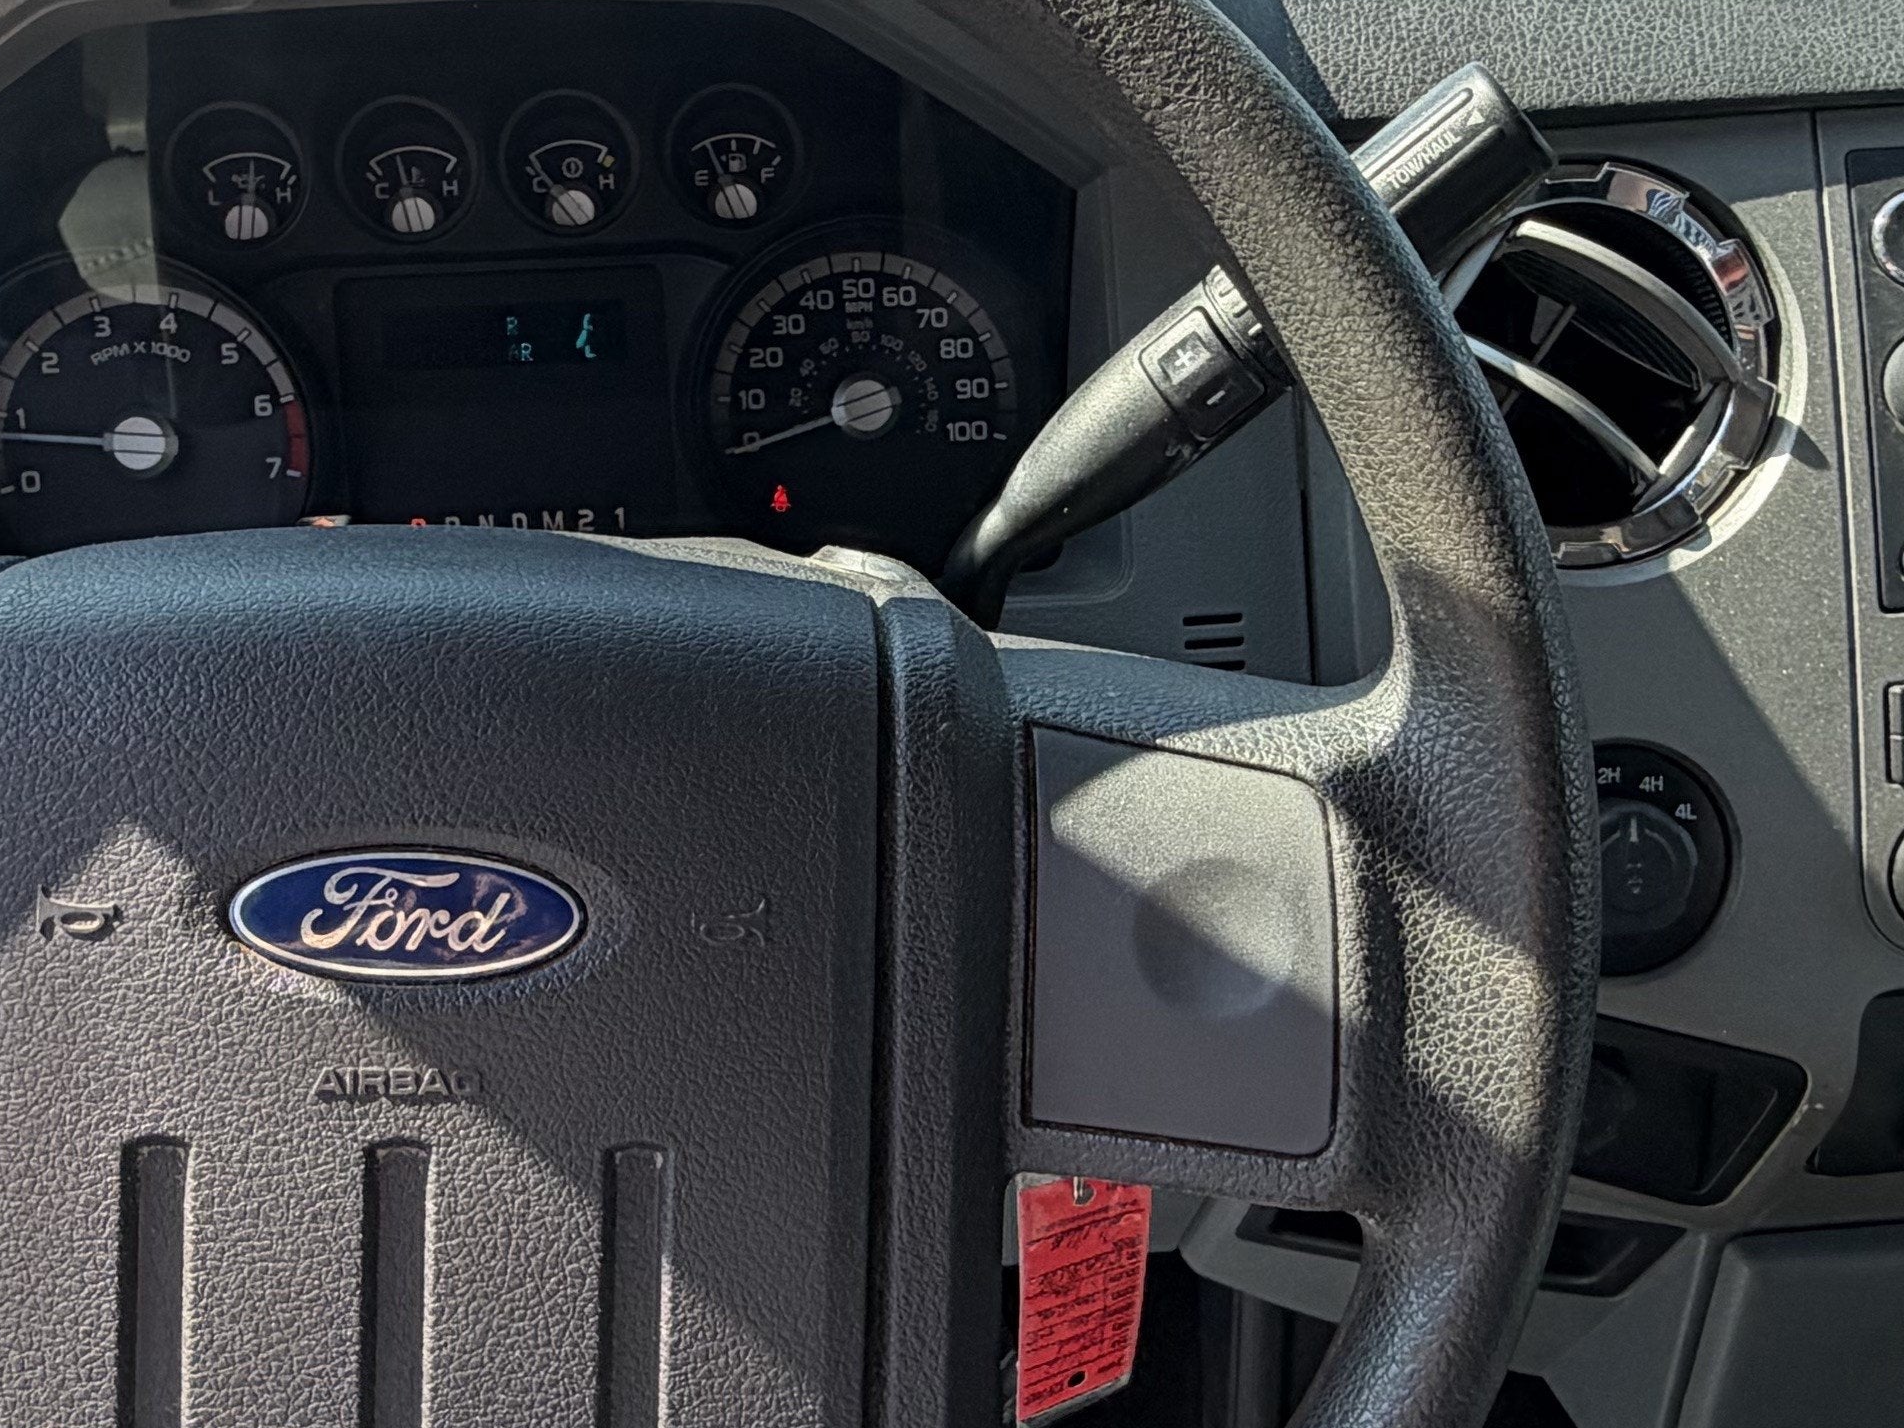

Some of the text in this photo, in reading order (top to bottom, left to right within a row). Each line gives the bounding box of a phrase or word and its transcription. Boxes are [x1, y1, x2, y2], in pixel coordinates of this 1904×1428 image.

[842, 277, 875, 299] 50
[882, 286, 917, 308] 60
[799, 289, 834, 310] 40
[94, 315, 112, 338] 3
[159, 312, 178, 334] 4
[772, 313, 806, 335] 30
[916, 307, 948, 329] 70
[90, 341, 130, 366] RPM
[151, 340, 191, 364] 1000
[220, 343, 240, 365] 5
[749, 347, 784, 369] 20
[940, 338, 974, 359] 80
[40, 351, 60, 374] 2
[738, 388, 766, 410] 10
[955, 378, 989, 400] 90
[253, 394, 273, 417] 6
[15, 407, 27, 430] 1
[946, 420, 988, 443] 100
[265, 456, 282, 480] 7
[20, 470, 41, 494] 0
[577, 508, 595, 531] 2
[614, 506, 626, 531] 1
[1597, 766, 1622, 785] 2H
[1638, 774, 1665, 793] 4H
[1673, 802, 1698, 821] 4L
[301, 866, 512, 953] Ford
